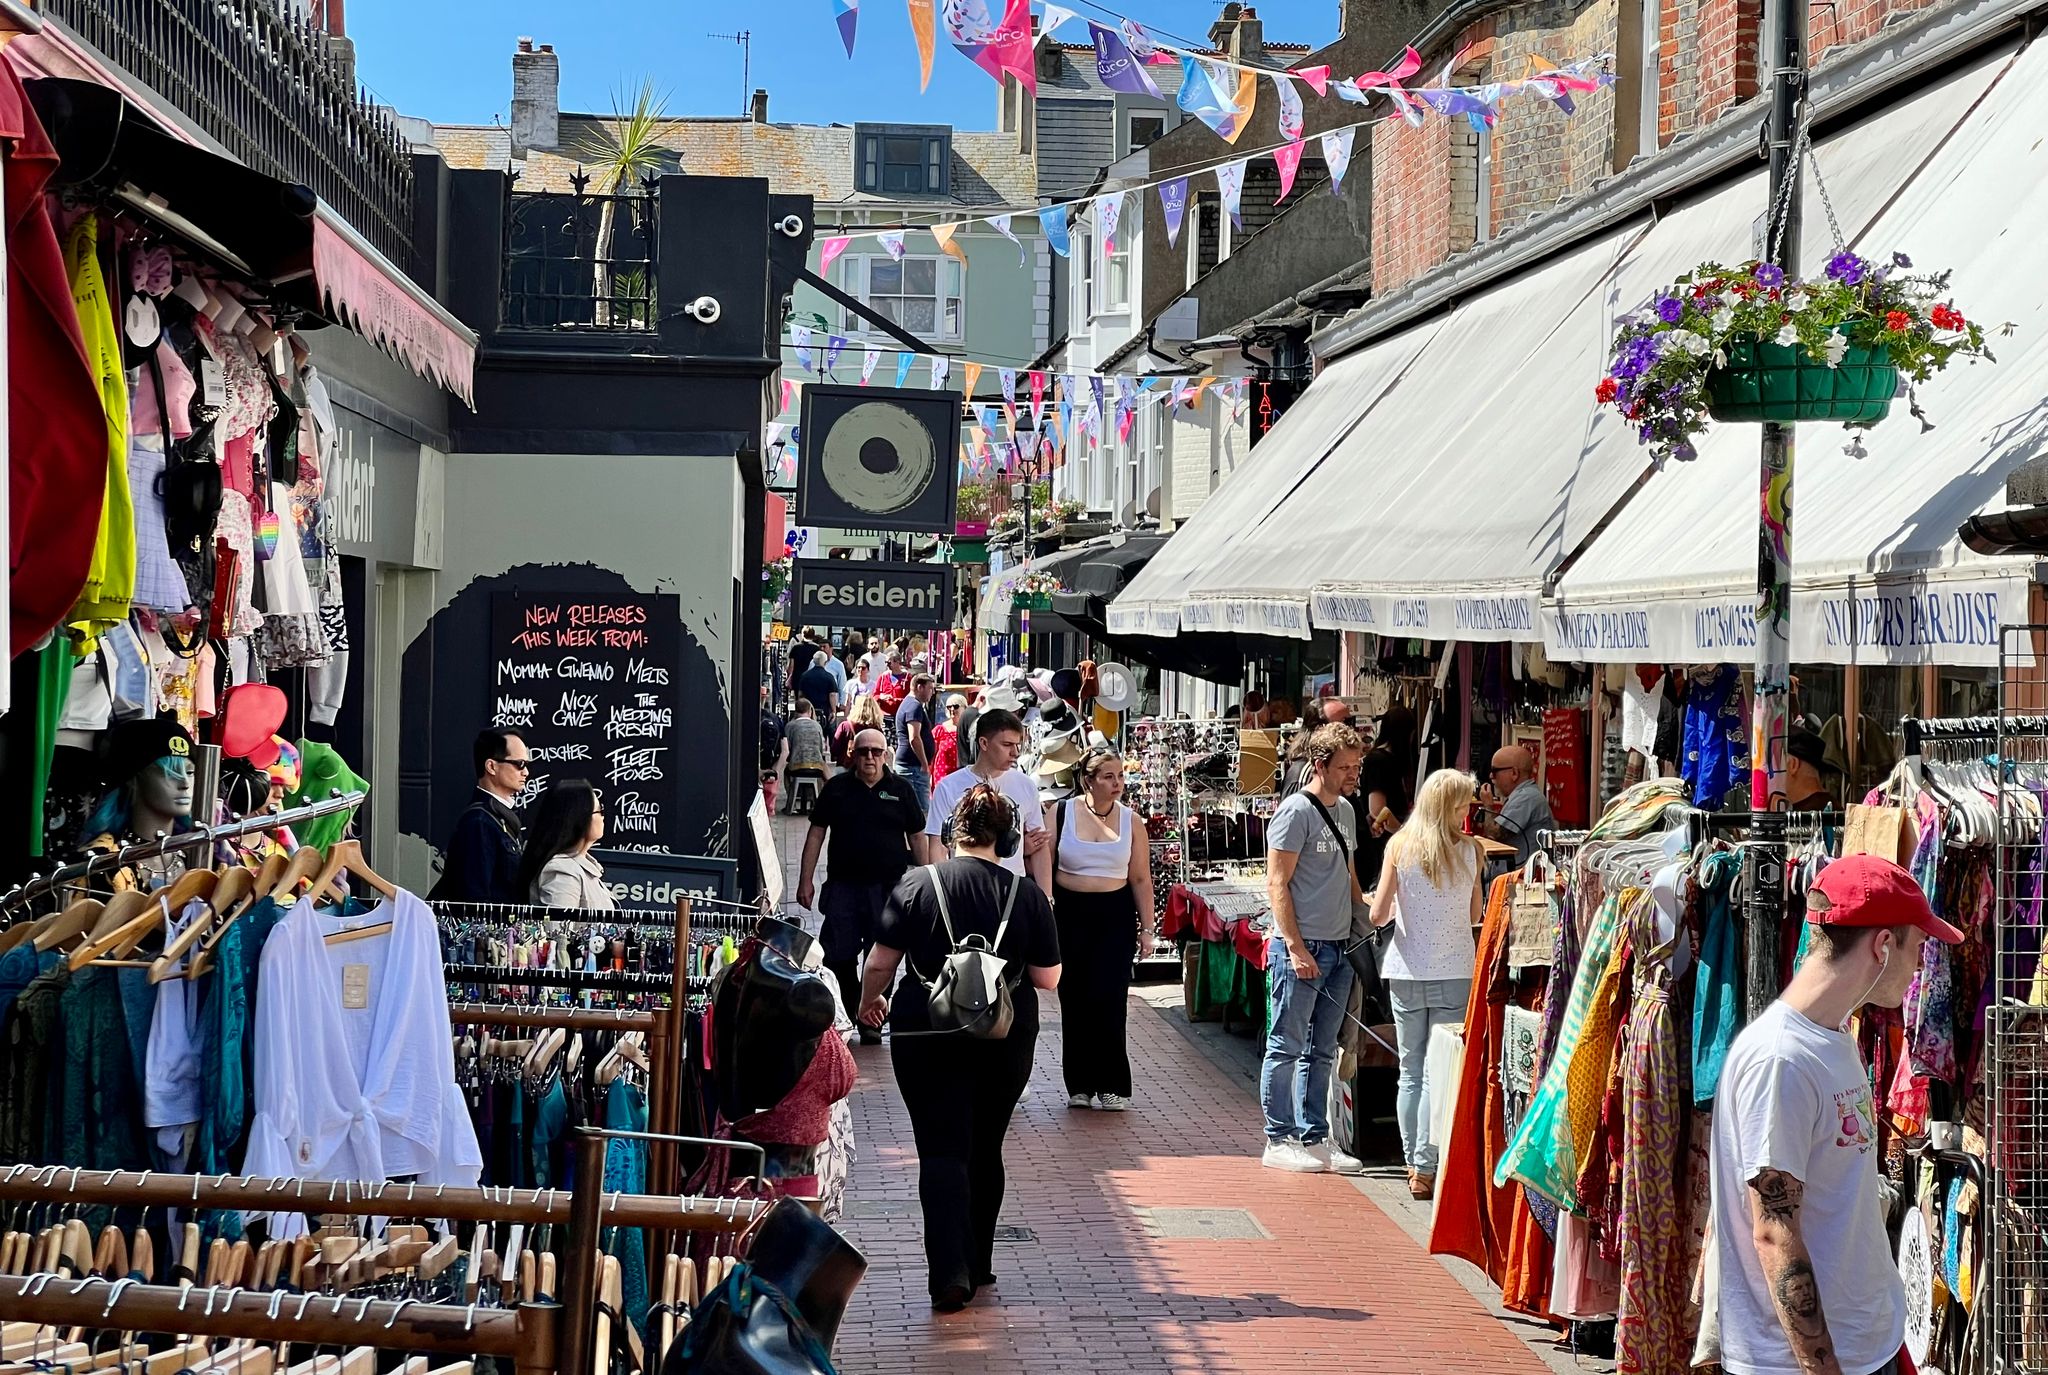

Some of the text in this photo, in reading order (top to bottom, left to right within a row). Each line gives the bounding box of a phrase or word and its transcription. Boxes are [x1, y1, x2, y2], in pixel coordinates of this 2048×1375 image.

[1258, 382, 1272, 435] TATT
[338, 427, 375, 543] ident
[803, 580, 941, 609] resident
[526, 604, 647, 628] NEW RELEASES
[1695, 605, 1757, 649] 0127360255
[1822, 592, 1999, 648] SNOOPERS PARADISE
[512, 628, 649, 651] THIS WEEK FROM:
[1600, 611, 1650, 649] PARADISE
[497, 693, 538, 715] NAIMA
[560, 689, 599, 714] NICK
[634, 693, 659, 707] THE
[552, 709, 594, 728] CAVE
[610, 705, 672, 728] WEDDING
[603, 721, 665, 740] PRESENT
[604, 745, 668, 769] FLEET
[604, 766, 664, 786] FOXES
[614, 791, 660, 817] PAOLO
